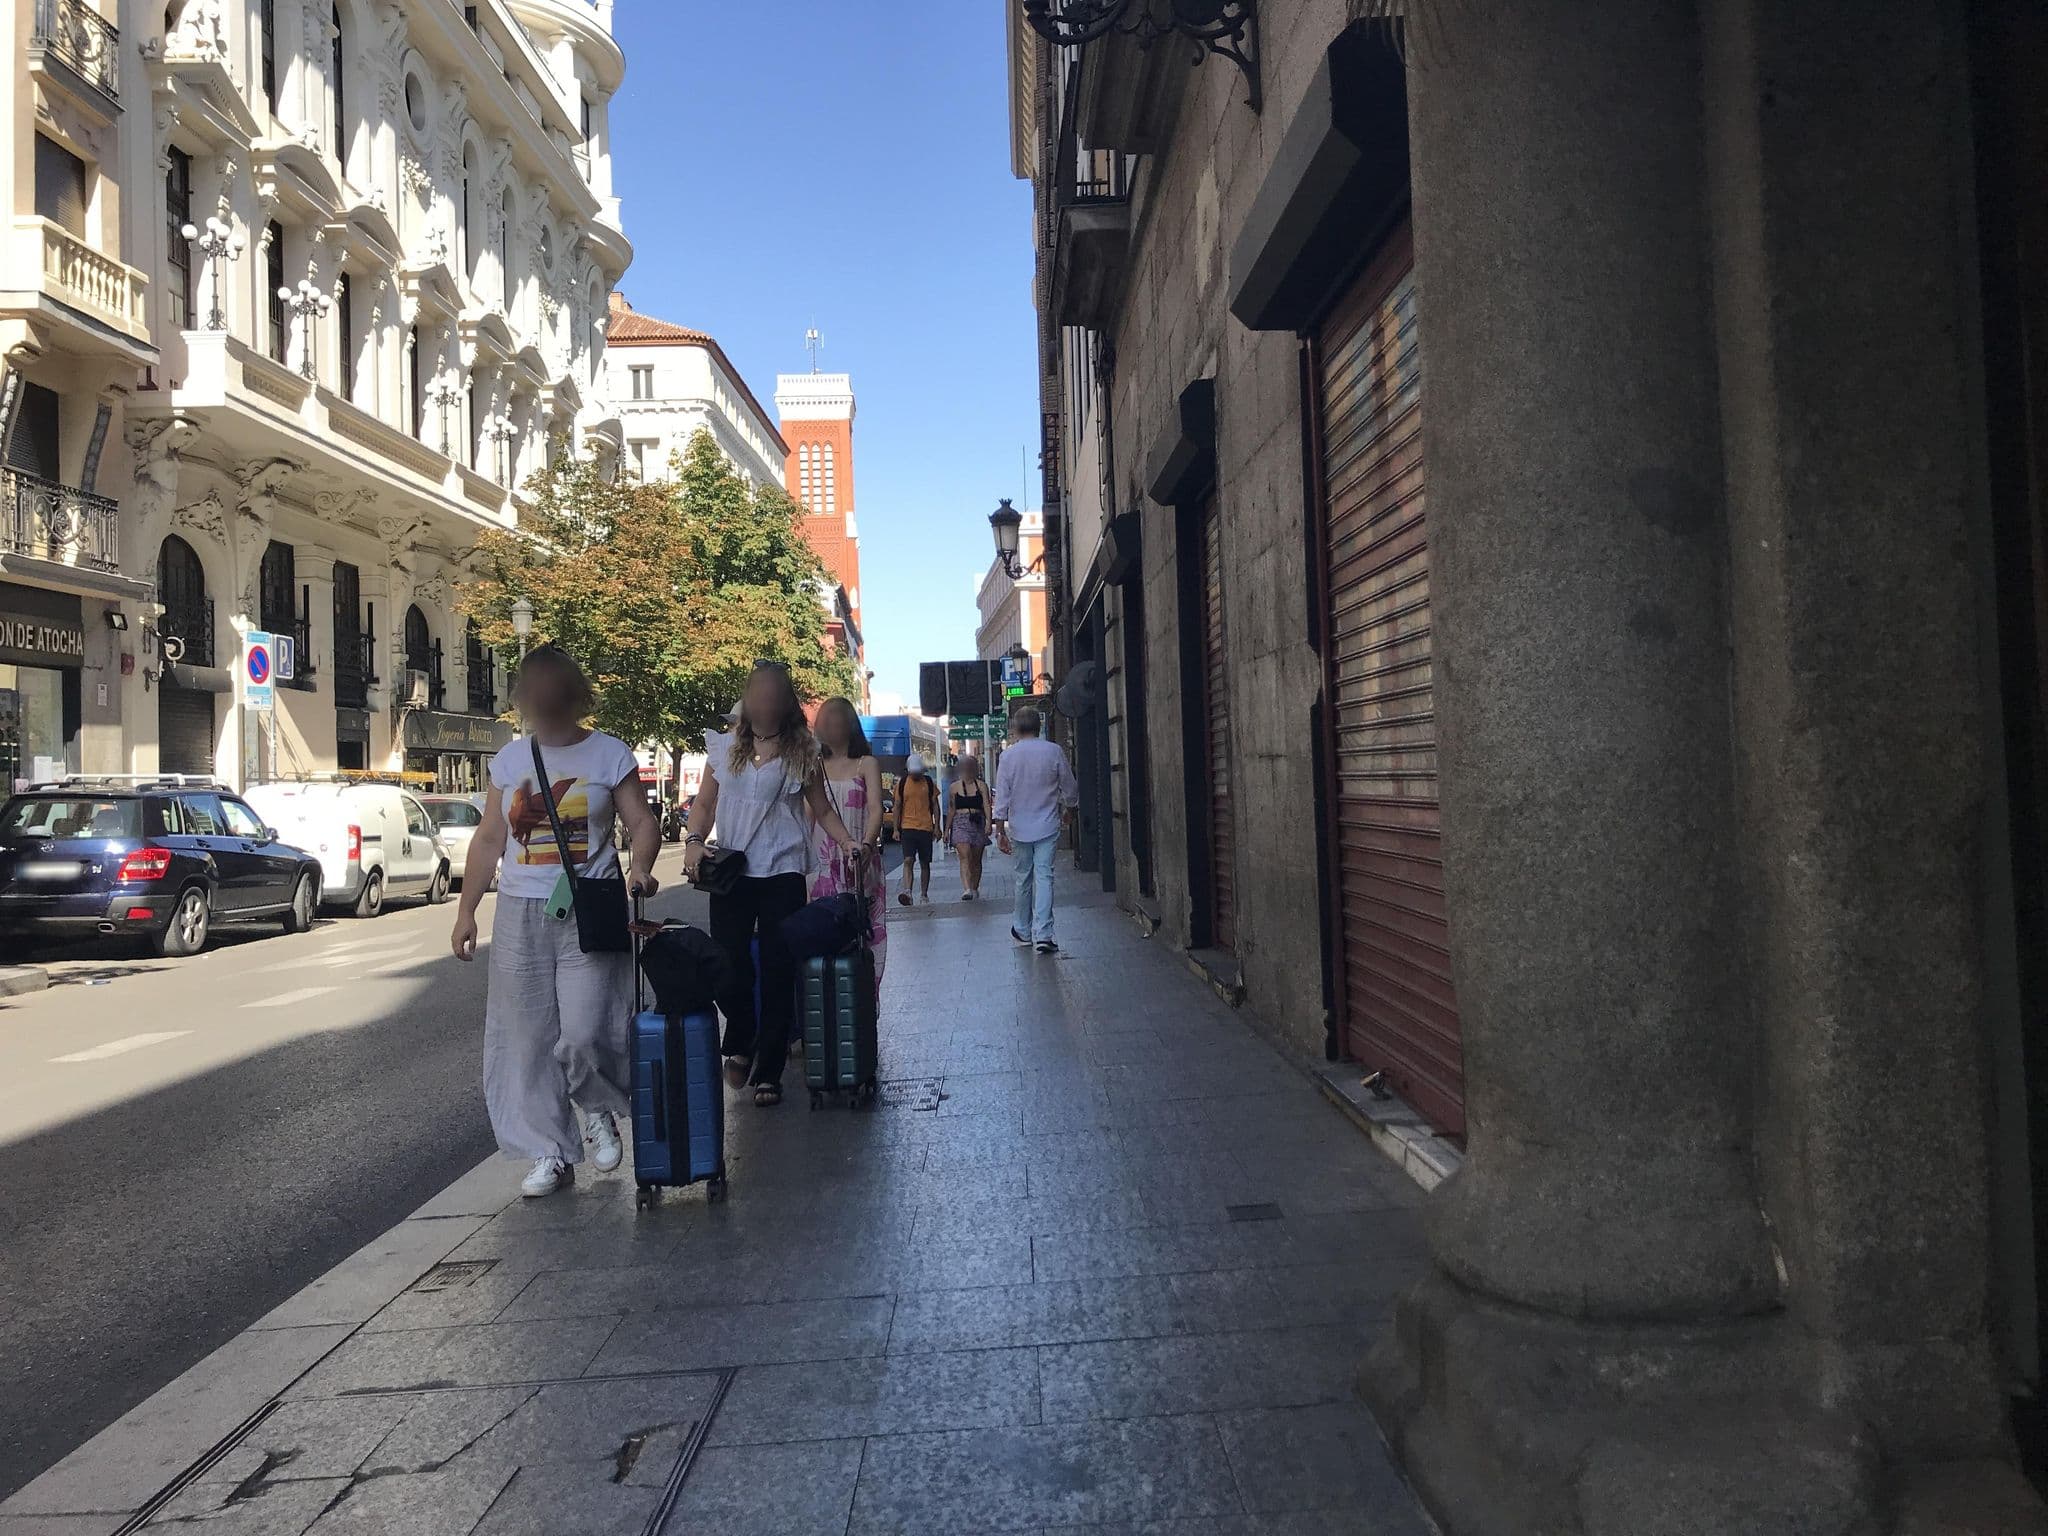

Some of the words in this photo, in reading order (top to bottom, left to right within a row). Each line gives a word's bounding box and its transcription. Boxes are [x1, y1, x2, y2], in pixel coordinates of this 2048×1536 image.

[17, 623, 33, 650] DE
[37, 626, 84, 656] ATOCHA
[279, 639, 288, 672] P
